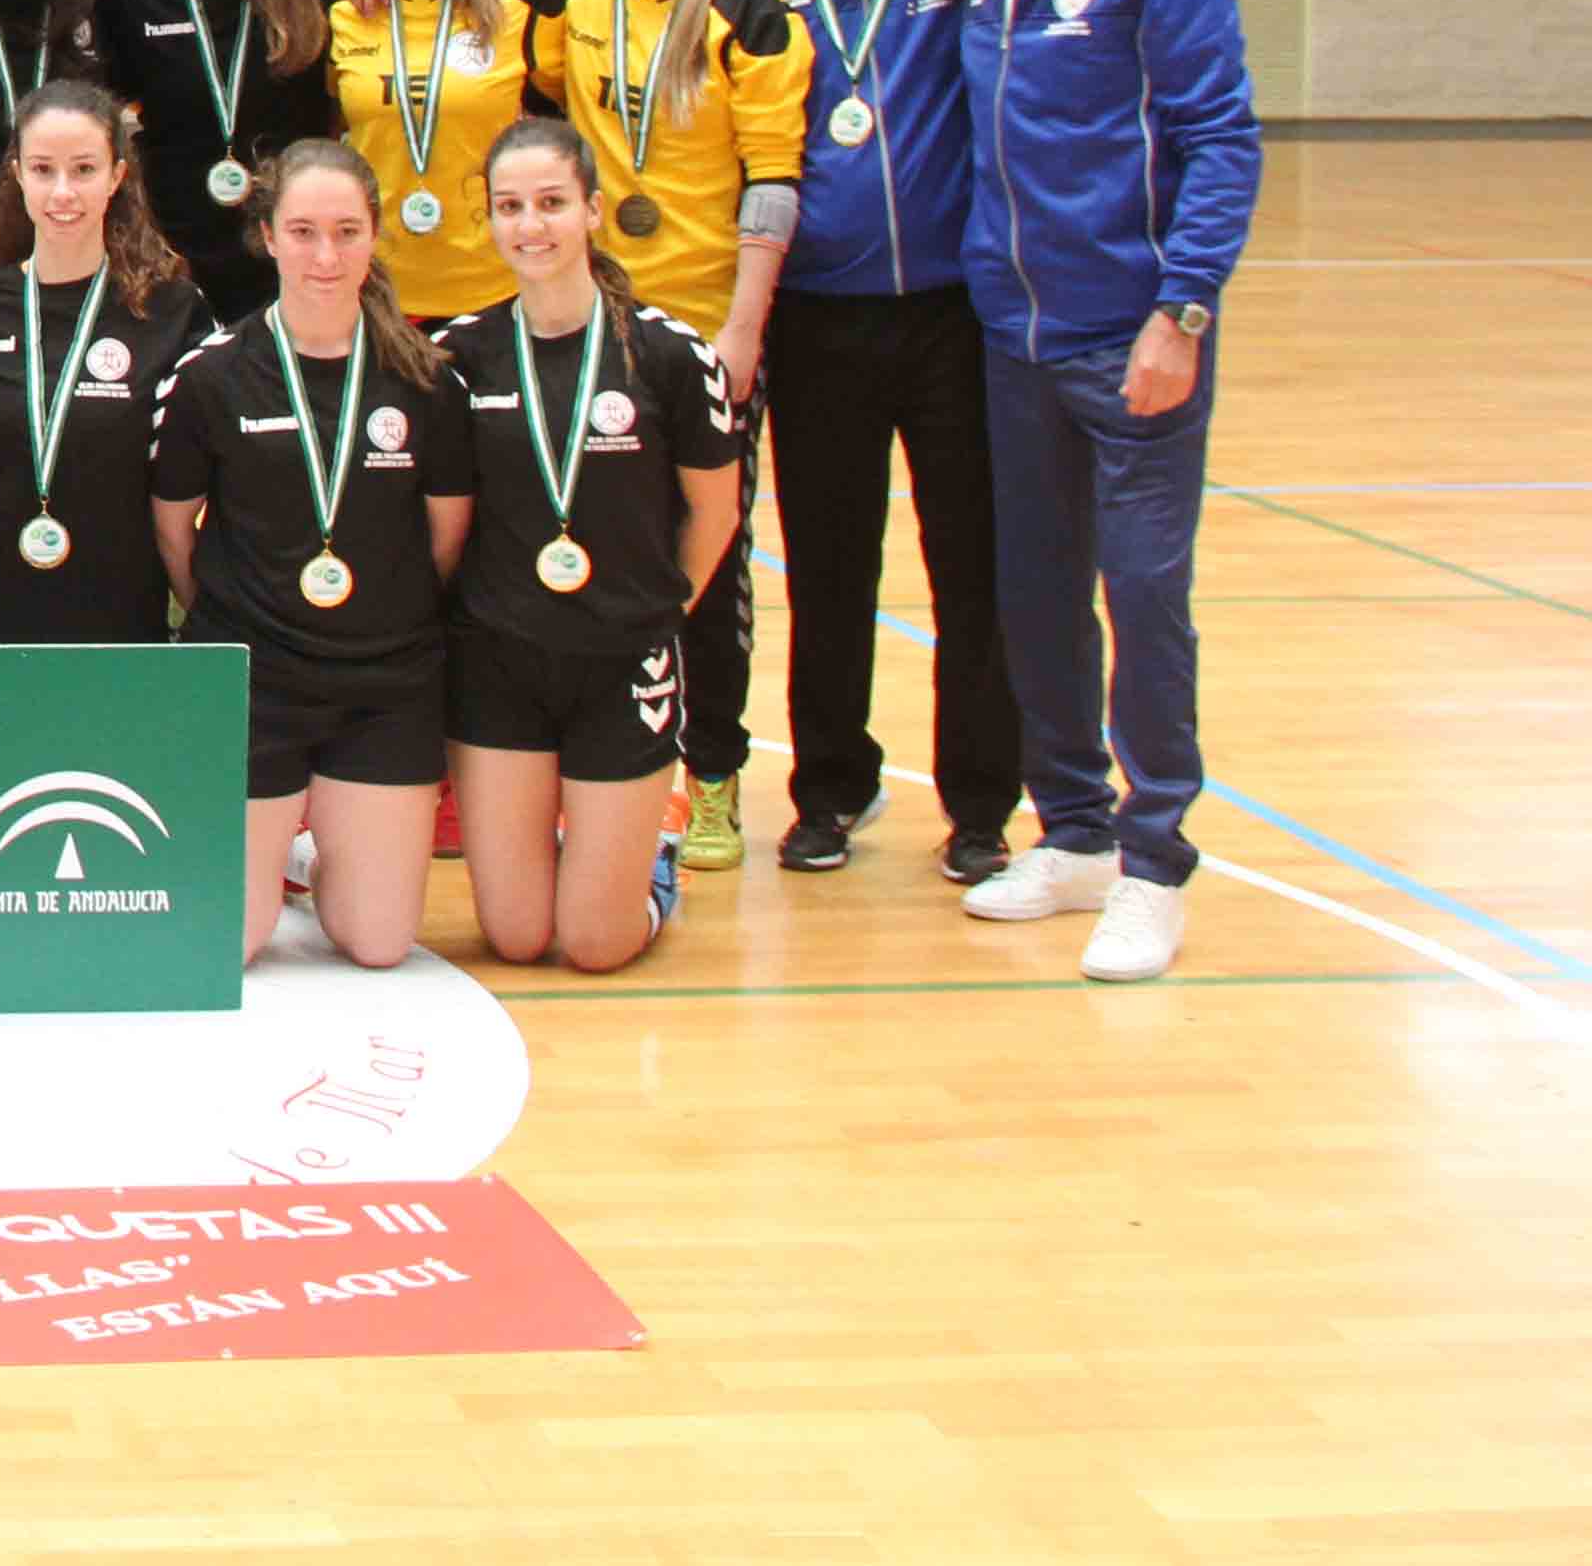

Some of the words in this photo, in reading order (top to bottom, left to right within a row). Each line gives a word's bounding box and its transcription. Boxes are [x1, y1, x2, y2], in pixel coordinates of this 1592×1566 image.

[37, 891, 60, 913] DE
[68, 890, 170, 912] ANDALUCIA
[52, 1287, 287, 1343] ESTÁN
[301, 1257, 471, 1305] AQUÍ
